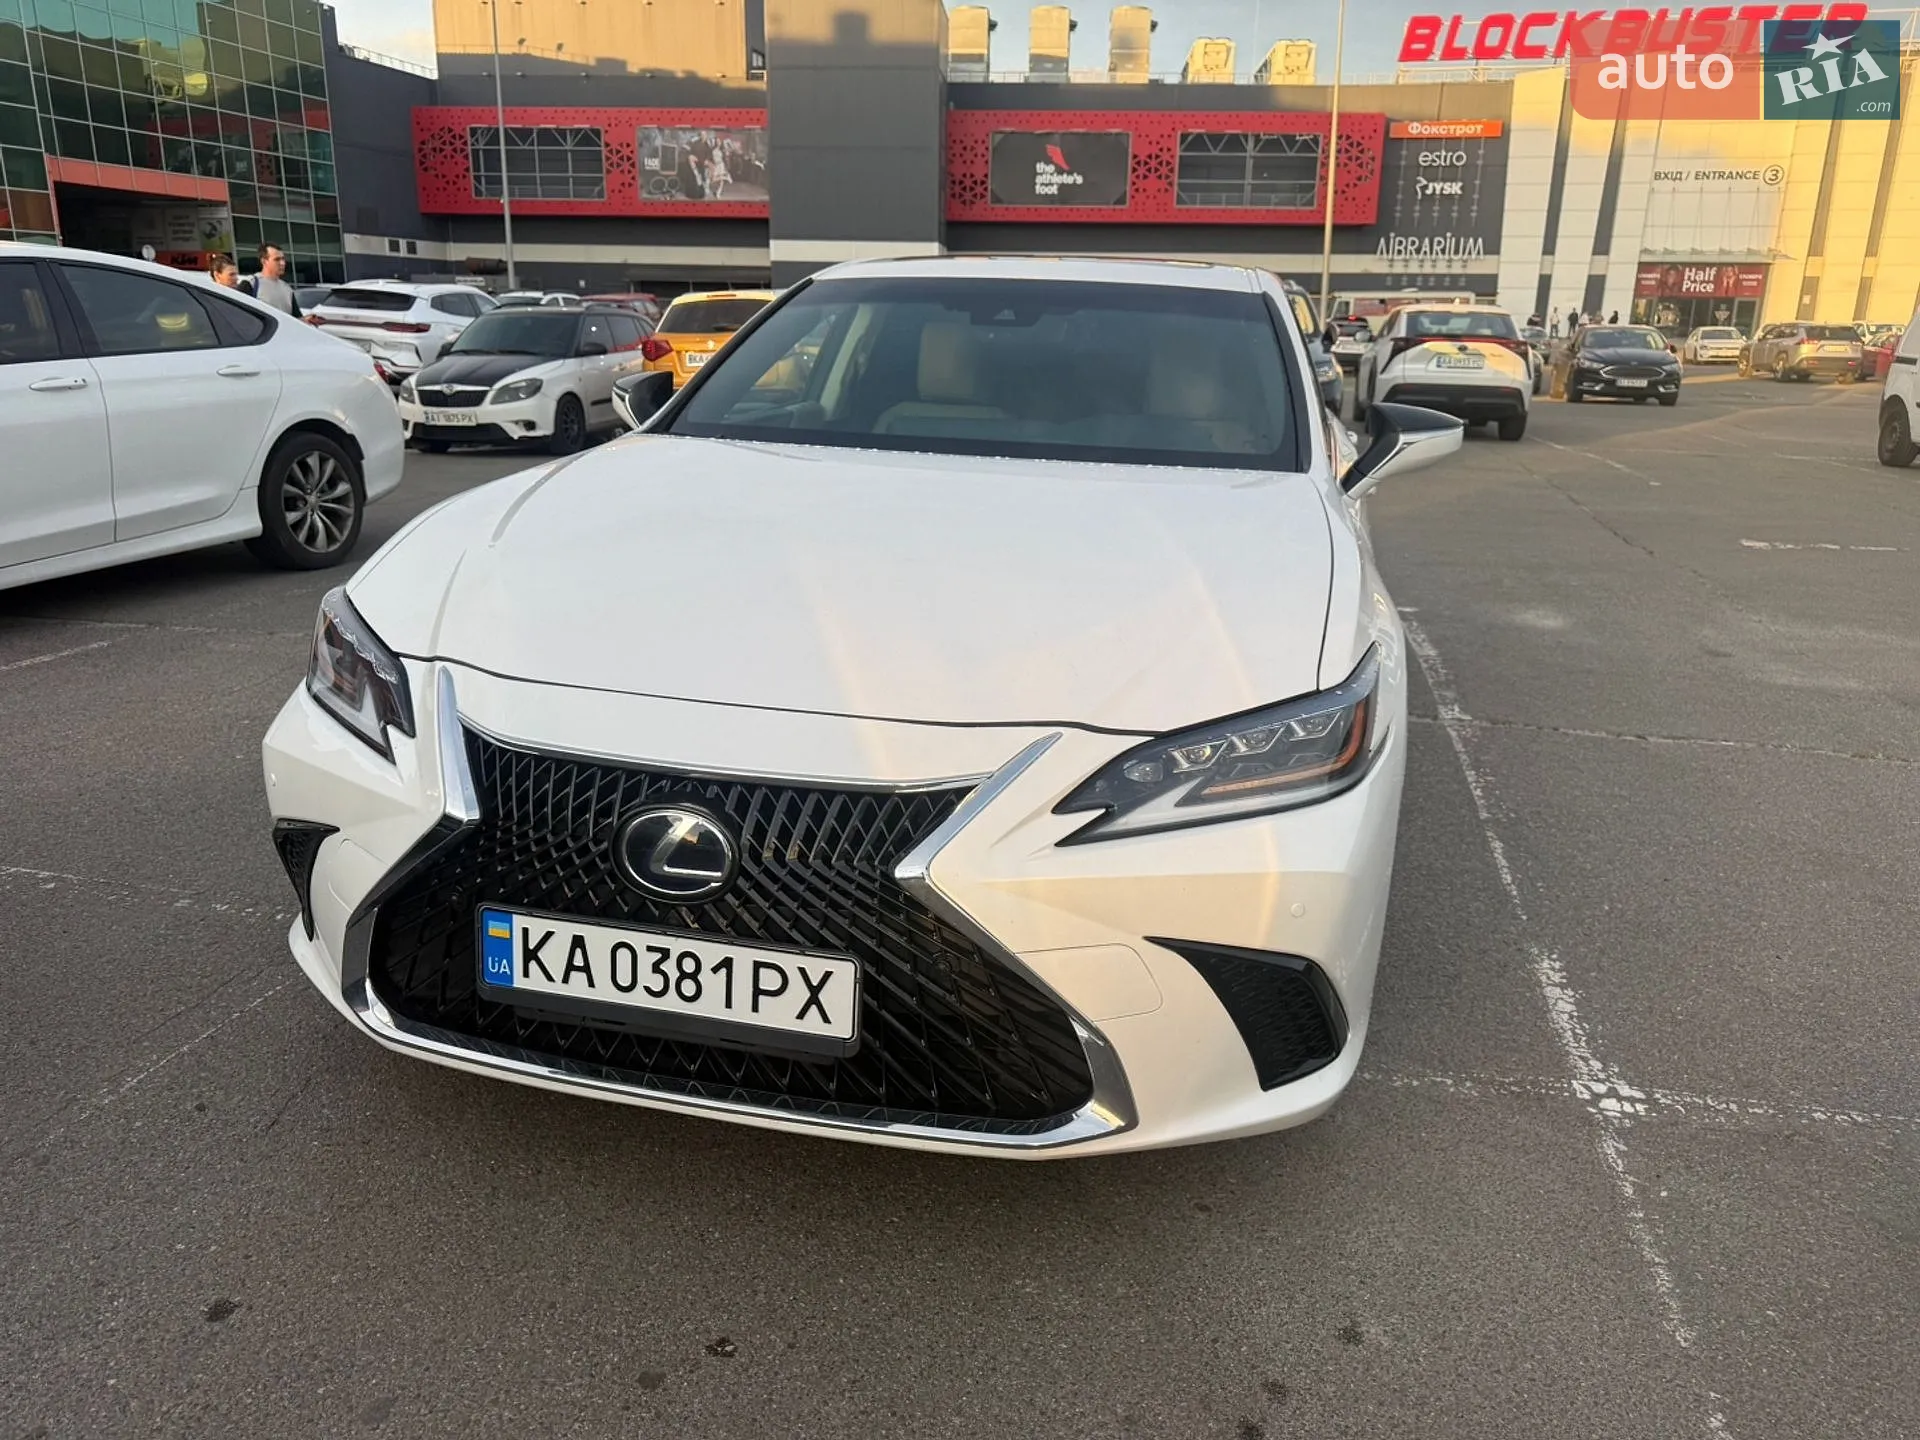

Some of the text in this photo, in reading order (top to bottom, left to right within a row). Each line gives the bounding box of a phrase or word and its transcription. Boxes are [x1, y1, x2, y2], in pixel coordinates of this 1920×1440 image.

[1398, 3, 1869, 62] BLOCKBUSTER
[1407, 121, 1484, 136] Фокстрот
[1418, 149, 1467, 166] estro
[1036, 161, 1055, 173] the
[1035, 172, 1083, 185] athlete's
[1654, 171, 1682, 181] ВХІД
[1694, 170, 1760, 181] ENTRANCE
[1035, 184, 1058, 194] foot
[1425, 182, 1463, 195] JYSK
[1683, 267, 1717, 281] Half
[1682, 281, 1715, 293] Price
[488, 956, 511, 976] UA
[522, 926, 834, 1024] KA 0381 PX
